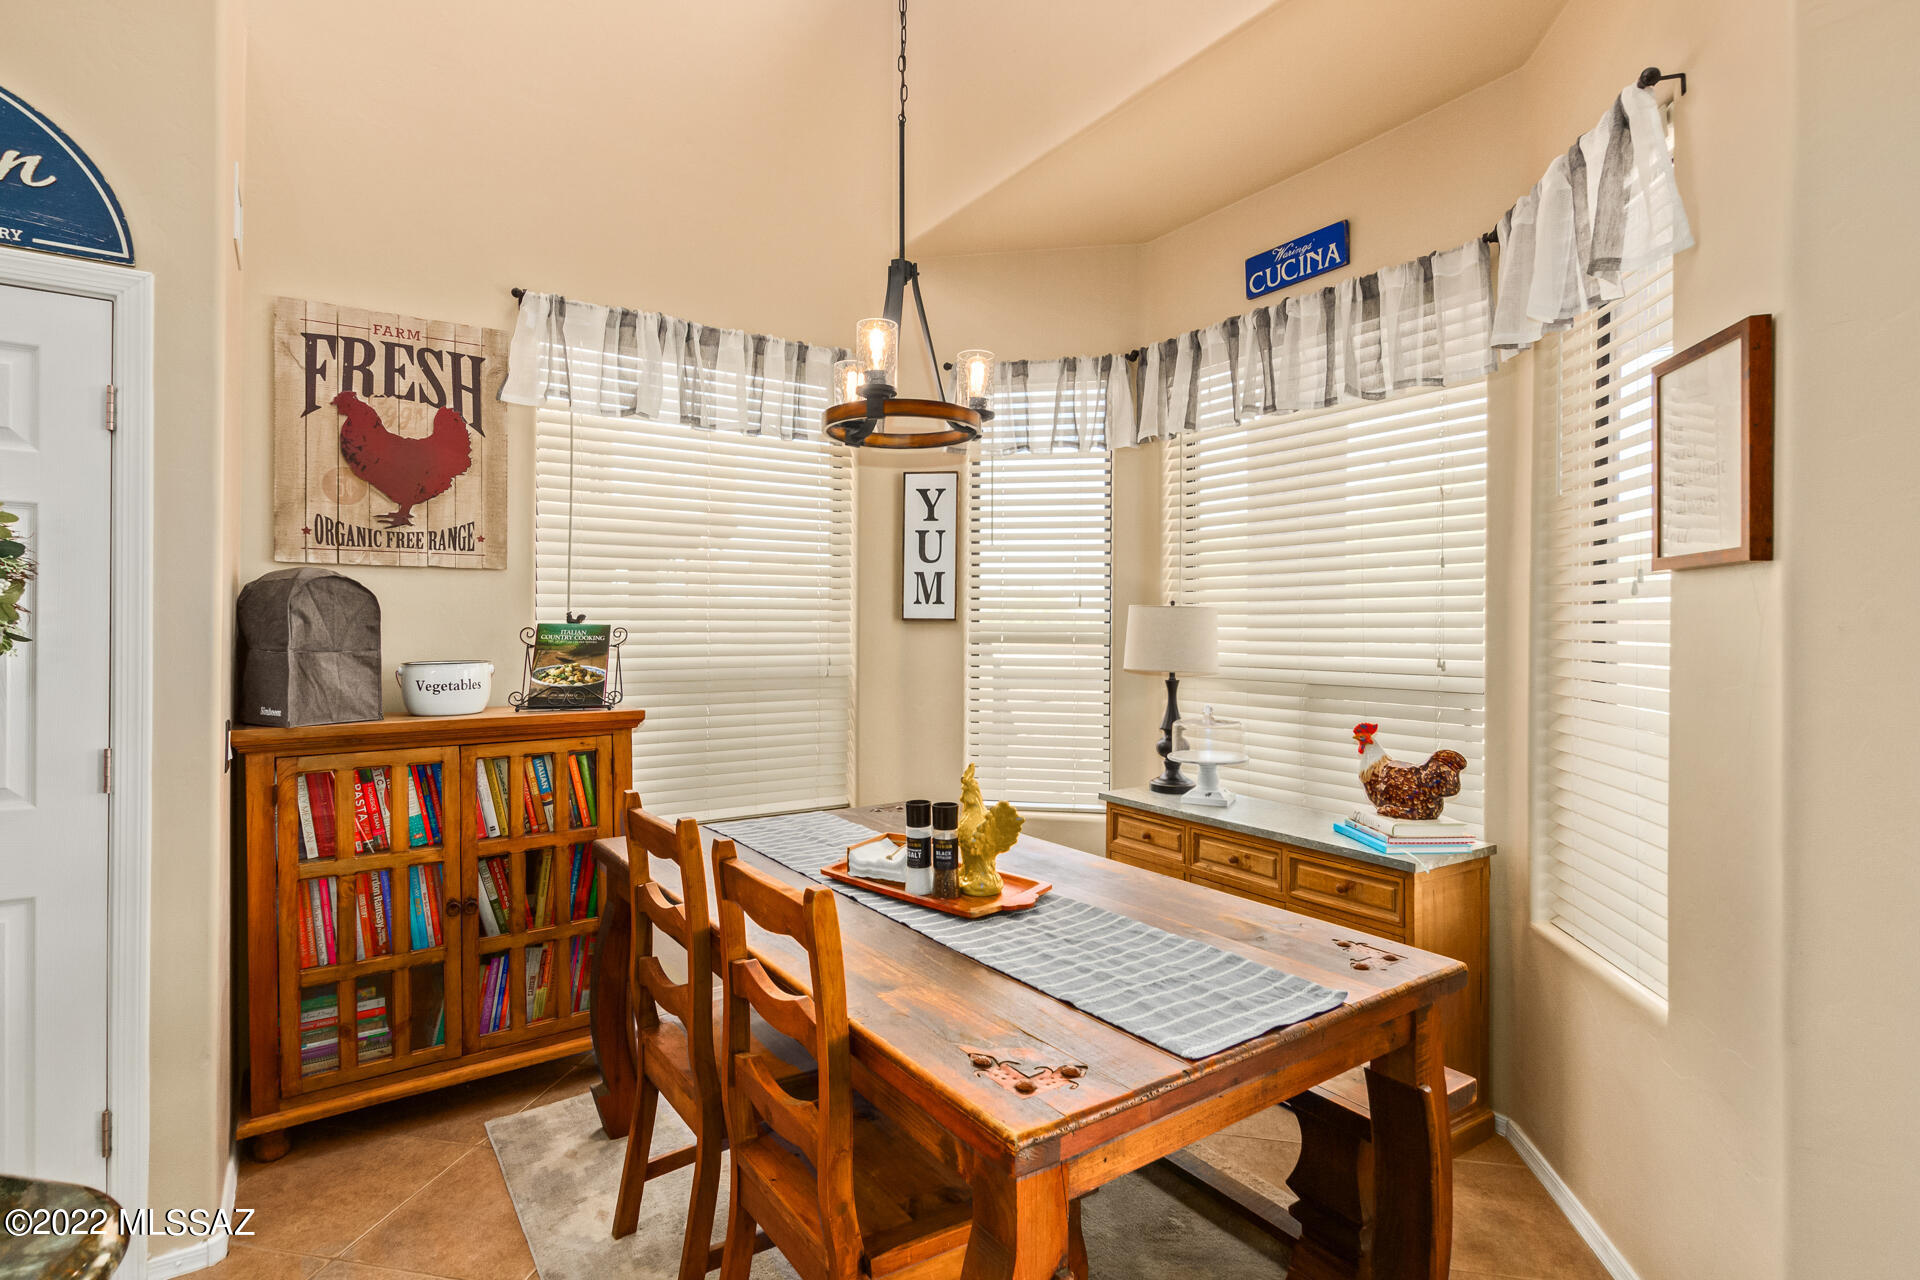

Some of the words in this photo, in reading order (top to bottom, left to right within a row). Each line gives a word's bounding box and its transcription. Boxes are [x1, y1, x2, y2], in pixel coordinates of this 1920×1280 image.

[1249, 242, 1341, 294] CUCINA
[373, 324, 420, 341] FARM
[300, 332, 486, 438] FRESH
[314, 513, 382, 548] ORGANIC
[386, 530, 424, 549] FREE
[428, 521, 475, 551] RANGE
[913, 488, 946, 605] YUM
[416, 678, 482, 695] Vegetables
[535, 759, 549, 789] ITALIAN
[354, 783, 368, 822] PASTA
[367, 787, 376, 811] HOMESICK
[300, 805, 314, 843] MEXICAN
[371, 871, 381, 896] ordon
[373, 895, 384, 928] Ramsay
